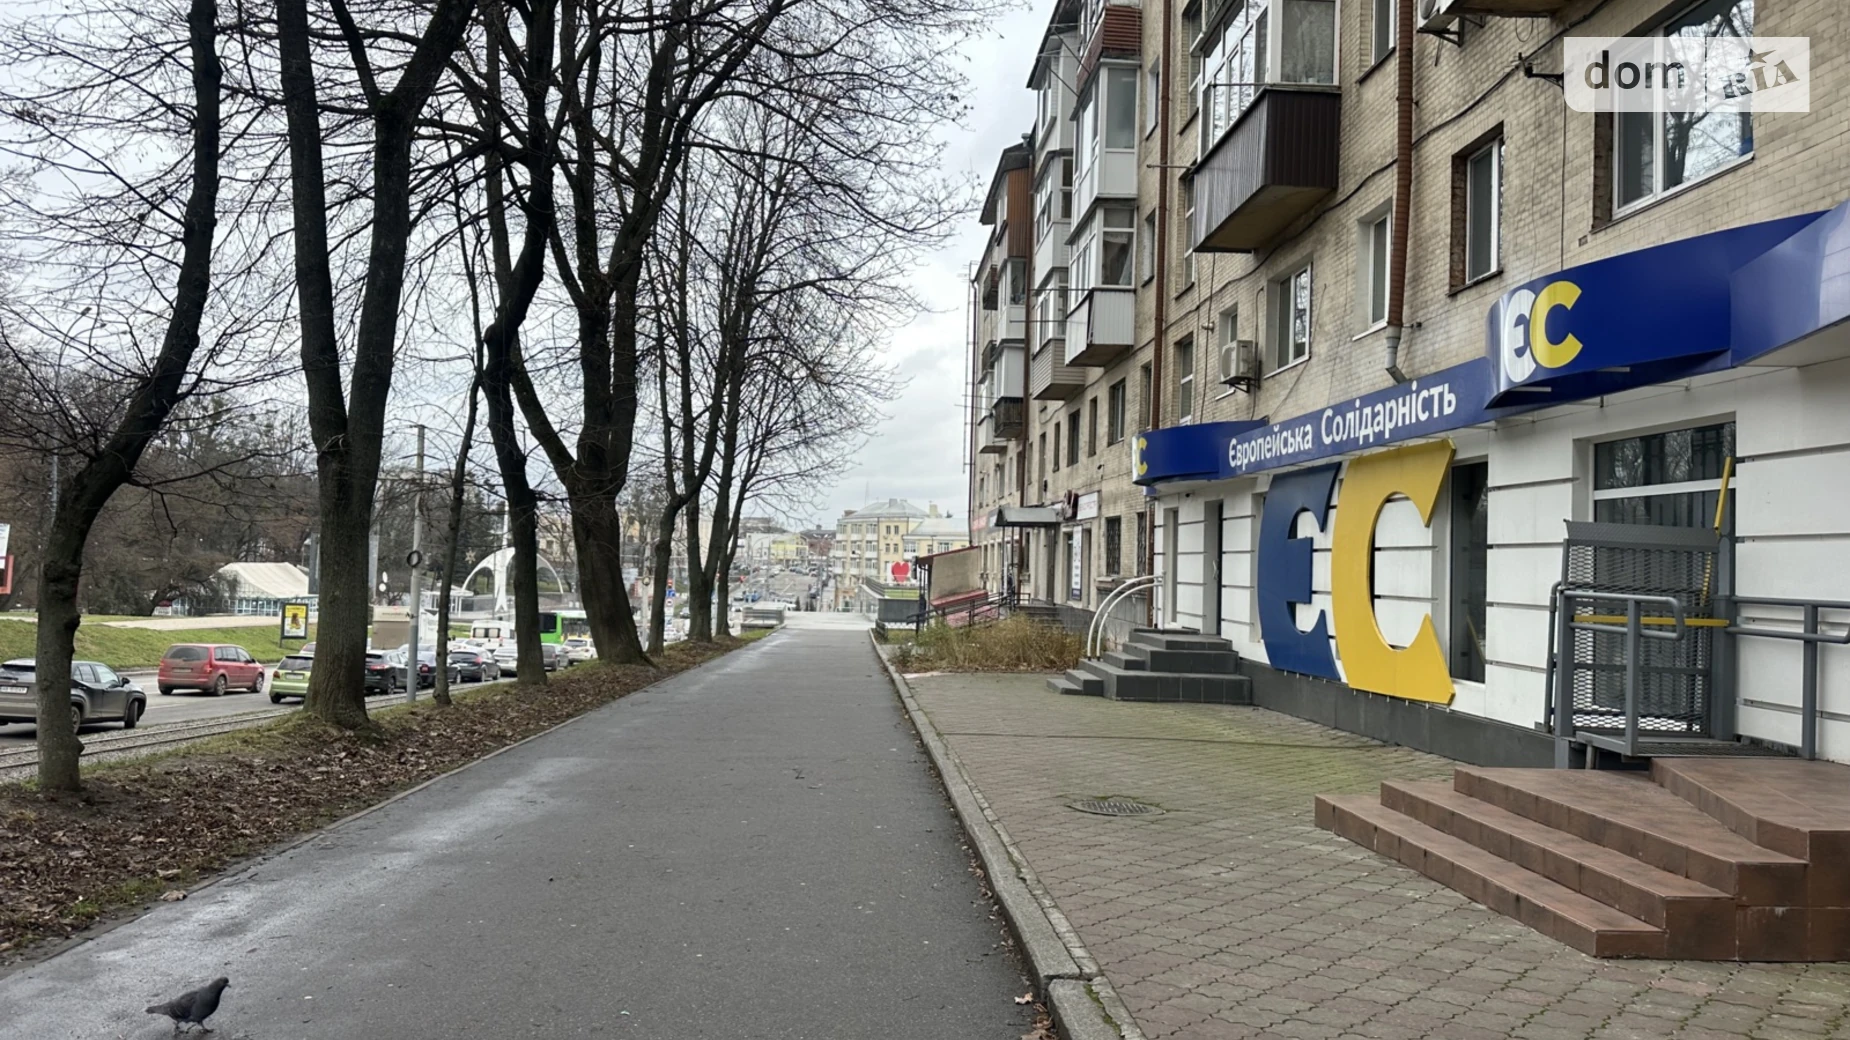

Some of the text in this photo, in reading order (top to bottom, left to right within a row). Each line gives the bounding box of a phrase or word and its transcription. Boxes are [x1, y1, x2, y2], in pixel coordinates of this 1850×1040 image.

[1503, 280, 1583, 383] ЄС
[1228, 380, 1457, 471] Європейська Солідарність
[1257, 440, 1457, 705] ЄС
